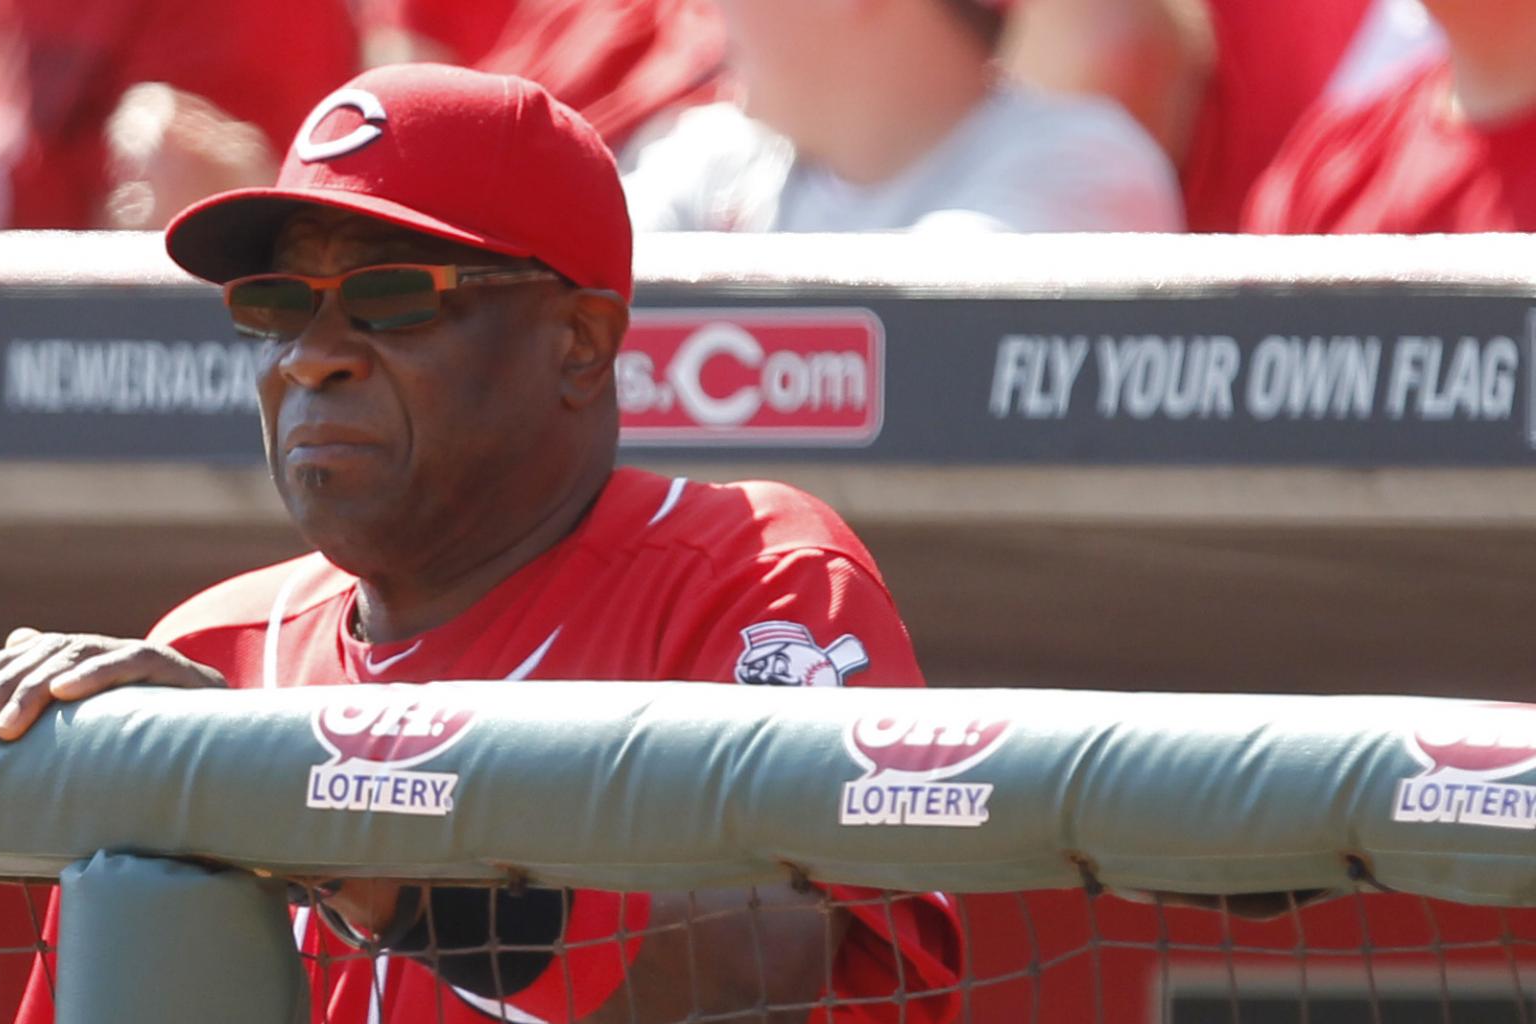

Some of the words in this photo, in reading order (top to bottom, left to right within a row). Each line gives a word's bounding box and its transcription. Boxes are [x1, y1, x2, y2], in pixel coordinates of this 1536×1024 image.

[296, 89, 387, 162] C
[988, 334, 1089, 419] FLY
[1096, 334, 1240, 419] YOUR
[1245, 334, 1381, 419] OWN
[1386, 334, 1520, 419] FLAG
[312, 773, 448, 808] LOTTERY
[846, 786, 984, 816] LOTTERY
